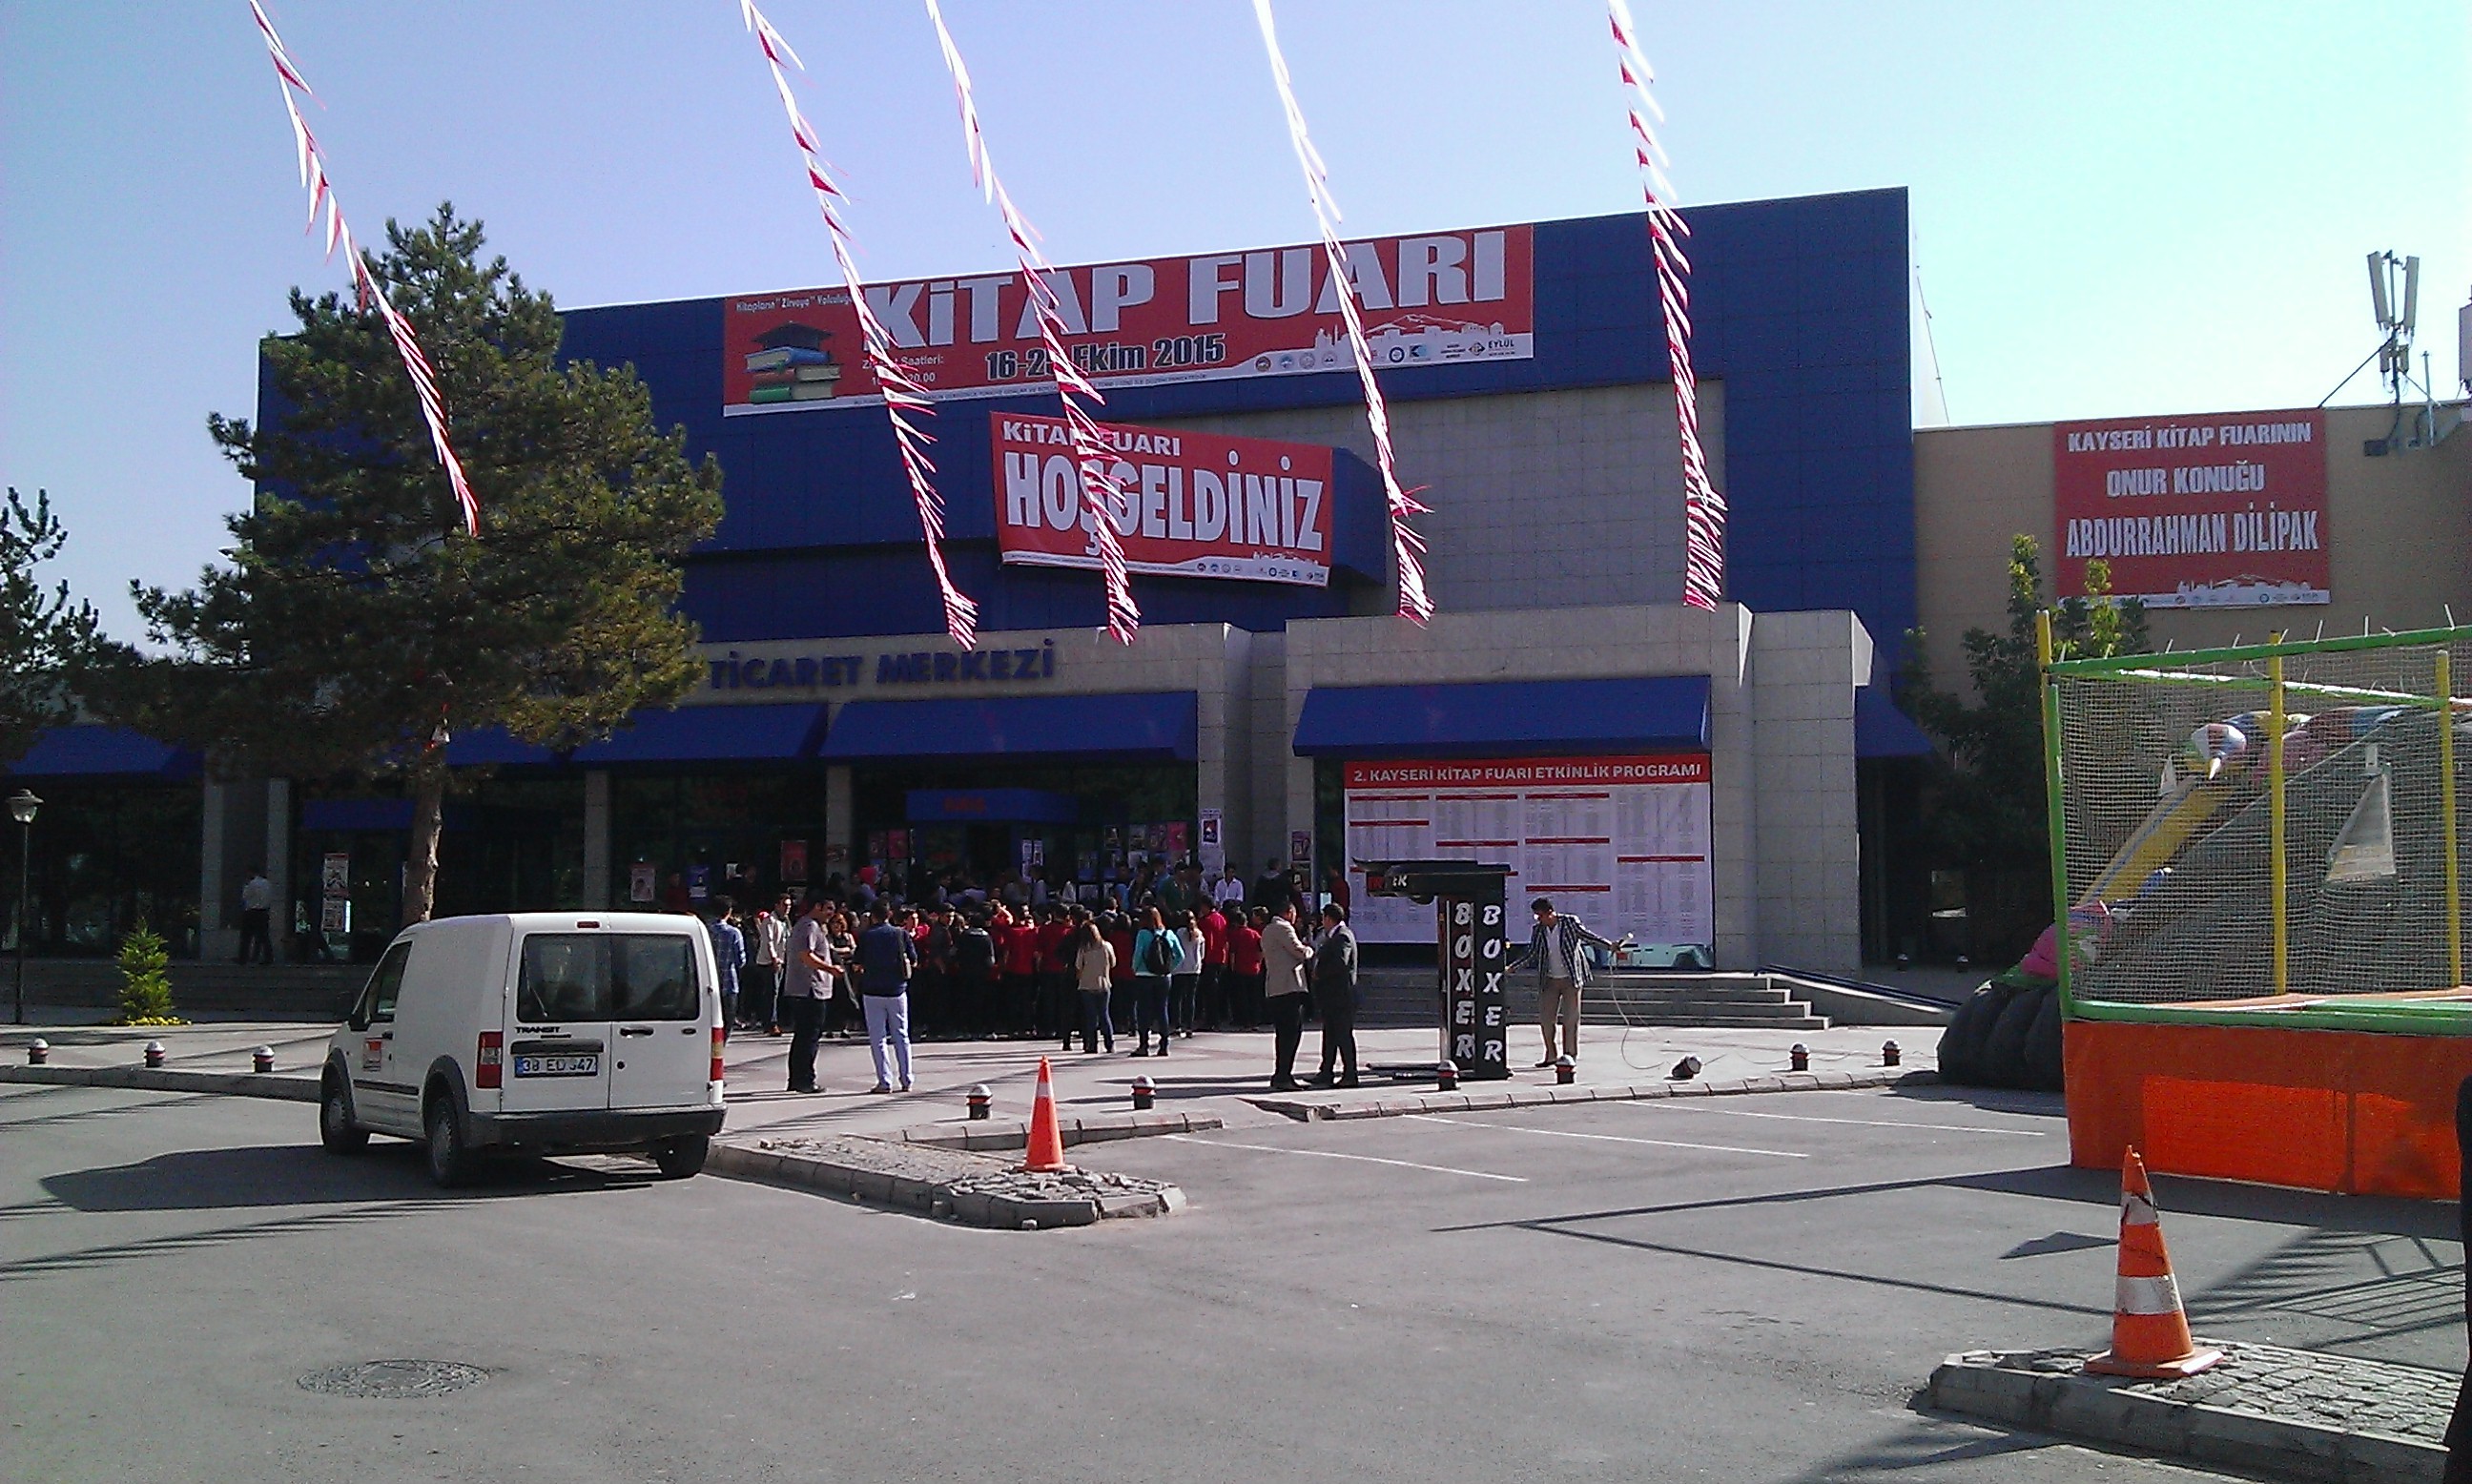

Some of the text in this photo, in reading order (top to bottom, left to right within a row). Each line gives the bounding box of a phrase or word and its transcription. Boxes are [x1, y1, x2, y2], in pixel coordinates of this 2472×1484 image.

[1188, 230, 1507, 325] FUARI
[1071, 342, 1146, 375] Ekim
[1152, 333, 1226, 368] 2015
[2068, 423, 2312, 452] KAYSERİ KİTAP FUARININ
[1003, 449, 1324, 556] HOŞGELDİNİZ
[2107, 460, 2265, 497] ONUR KONUĞU
[2066, 501, 2319, 557] ABDURRAHMAN DİLİPAK
[709, 638, 1057, 689] TİCARET MERKEZİ
[1370, 766, 1433, 781] KAYSERİ
[1436, 766, 1481, 780] KİTAP
[1485, 767, 1532, 780] FUARI
[1535, 763, 1610, 778] ETKİNLİK
[1613, 763, 1700, 777] PROGRAMI
[1454, 902, 1474, 1060] BOXER
[1482, 905, 1503, 1062] BOXER
